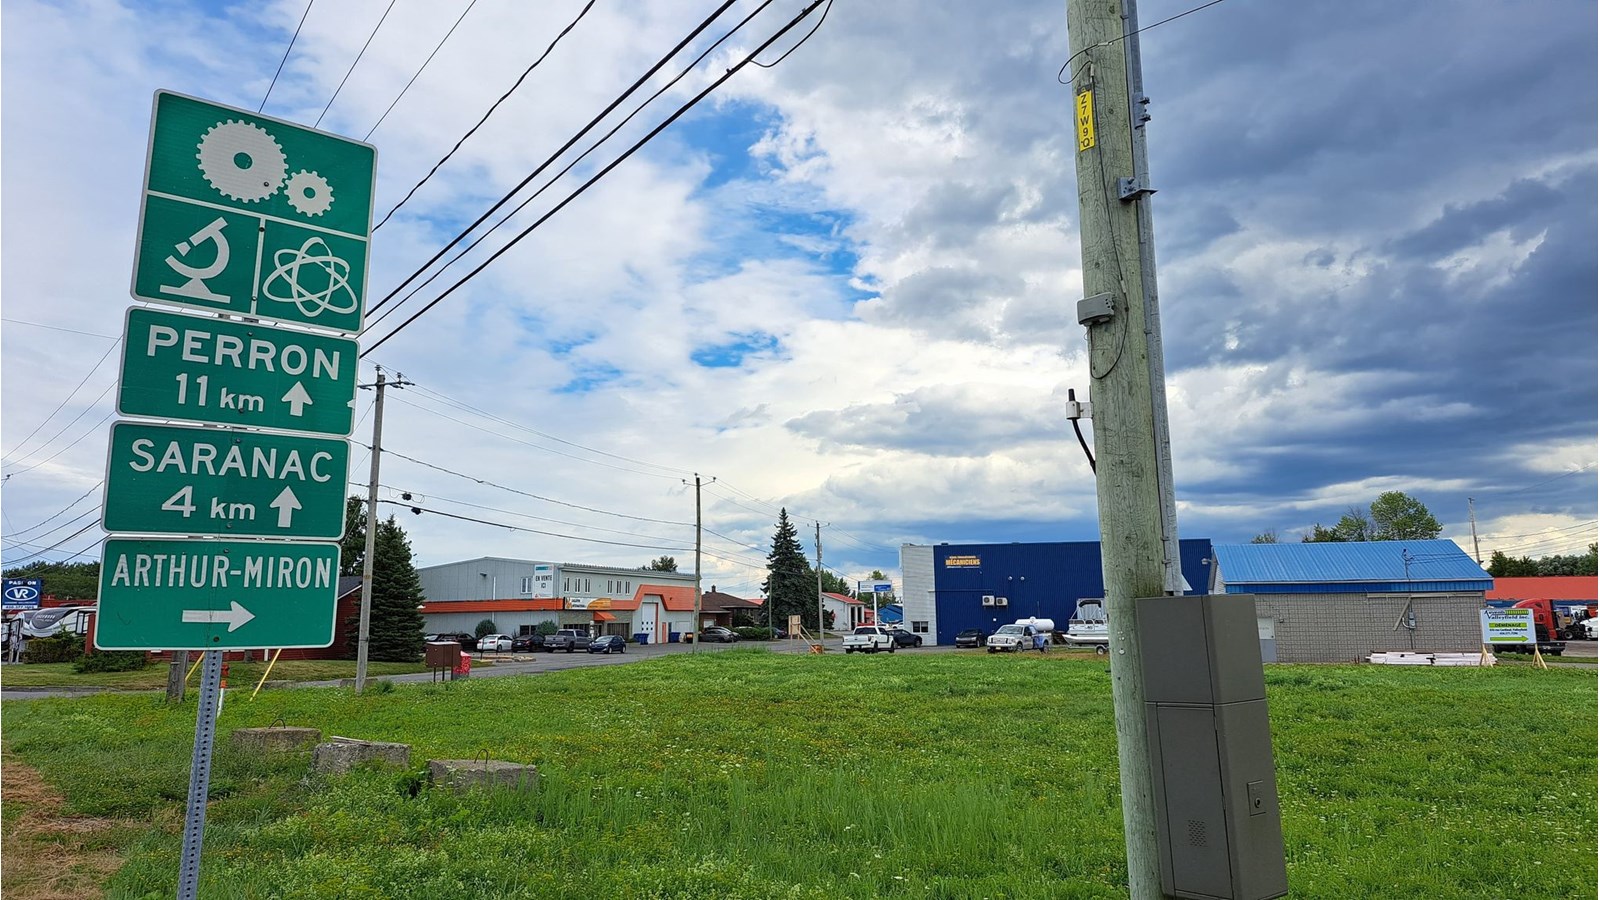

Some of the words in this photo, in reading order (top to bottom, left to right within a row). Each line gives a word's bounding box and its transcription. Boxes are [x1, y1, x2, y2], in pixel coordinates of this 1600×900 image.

[147, 324, 340, 381] PERRON
[175, 372, 209, 407] 11
[219, 387, 264, 412] km
[129, 438, 333, 483] SARANAC
[161, 485, 196, 518] 4
[210, 496, 256, 520] km
[111, 553, 331, 589] ARTHUR-MIRON
[13, 588, 29, 598] VR
